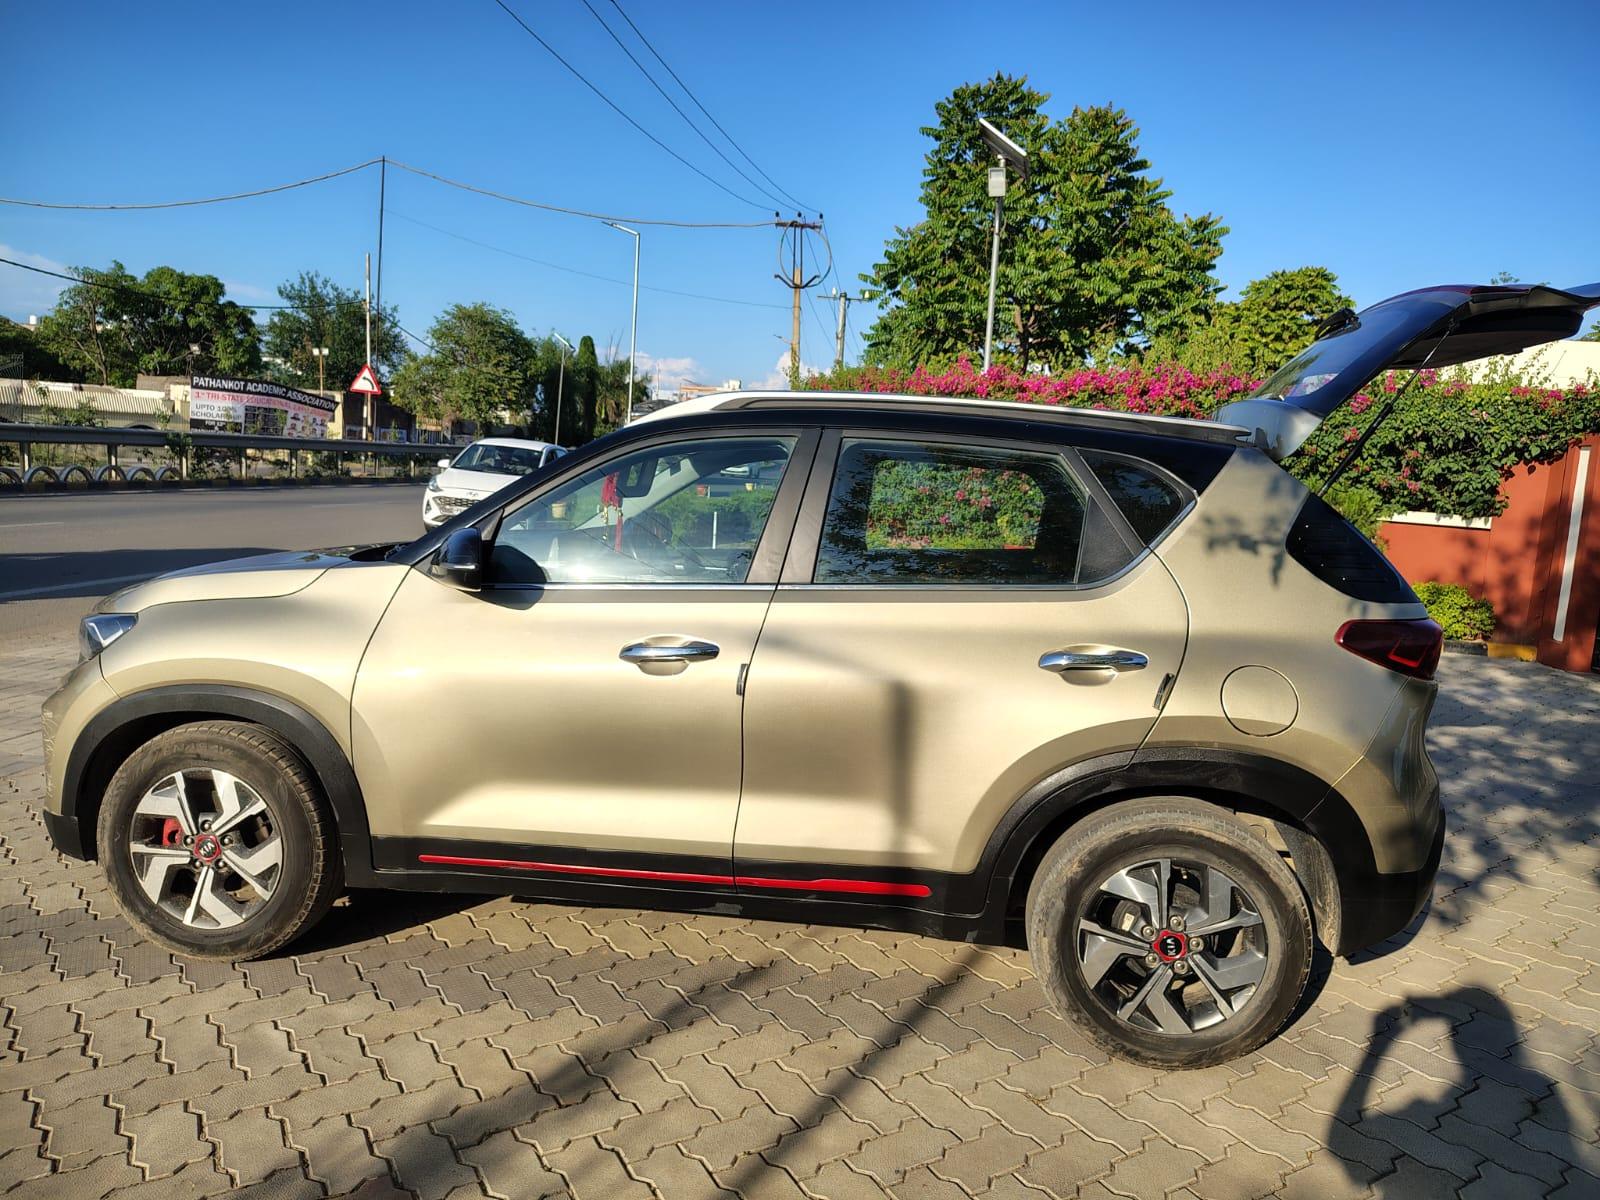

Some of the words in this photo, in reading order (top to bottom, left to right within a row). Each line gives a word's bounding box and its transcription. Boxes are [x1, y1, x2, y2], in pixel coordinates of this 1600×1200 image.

[193, 376, 245, 391] PATHANKOT
[246, 381, 287, 396] ACADEMIC
[287, 389, 336, 410] ASSOCIATION
[199, 842, 215, 856] KIA
[1166, 938, 1176, 956] KIA
